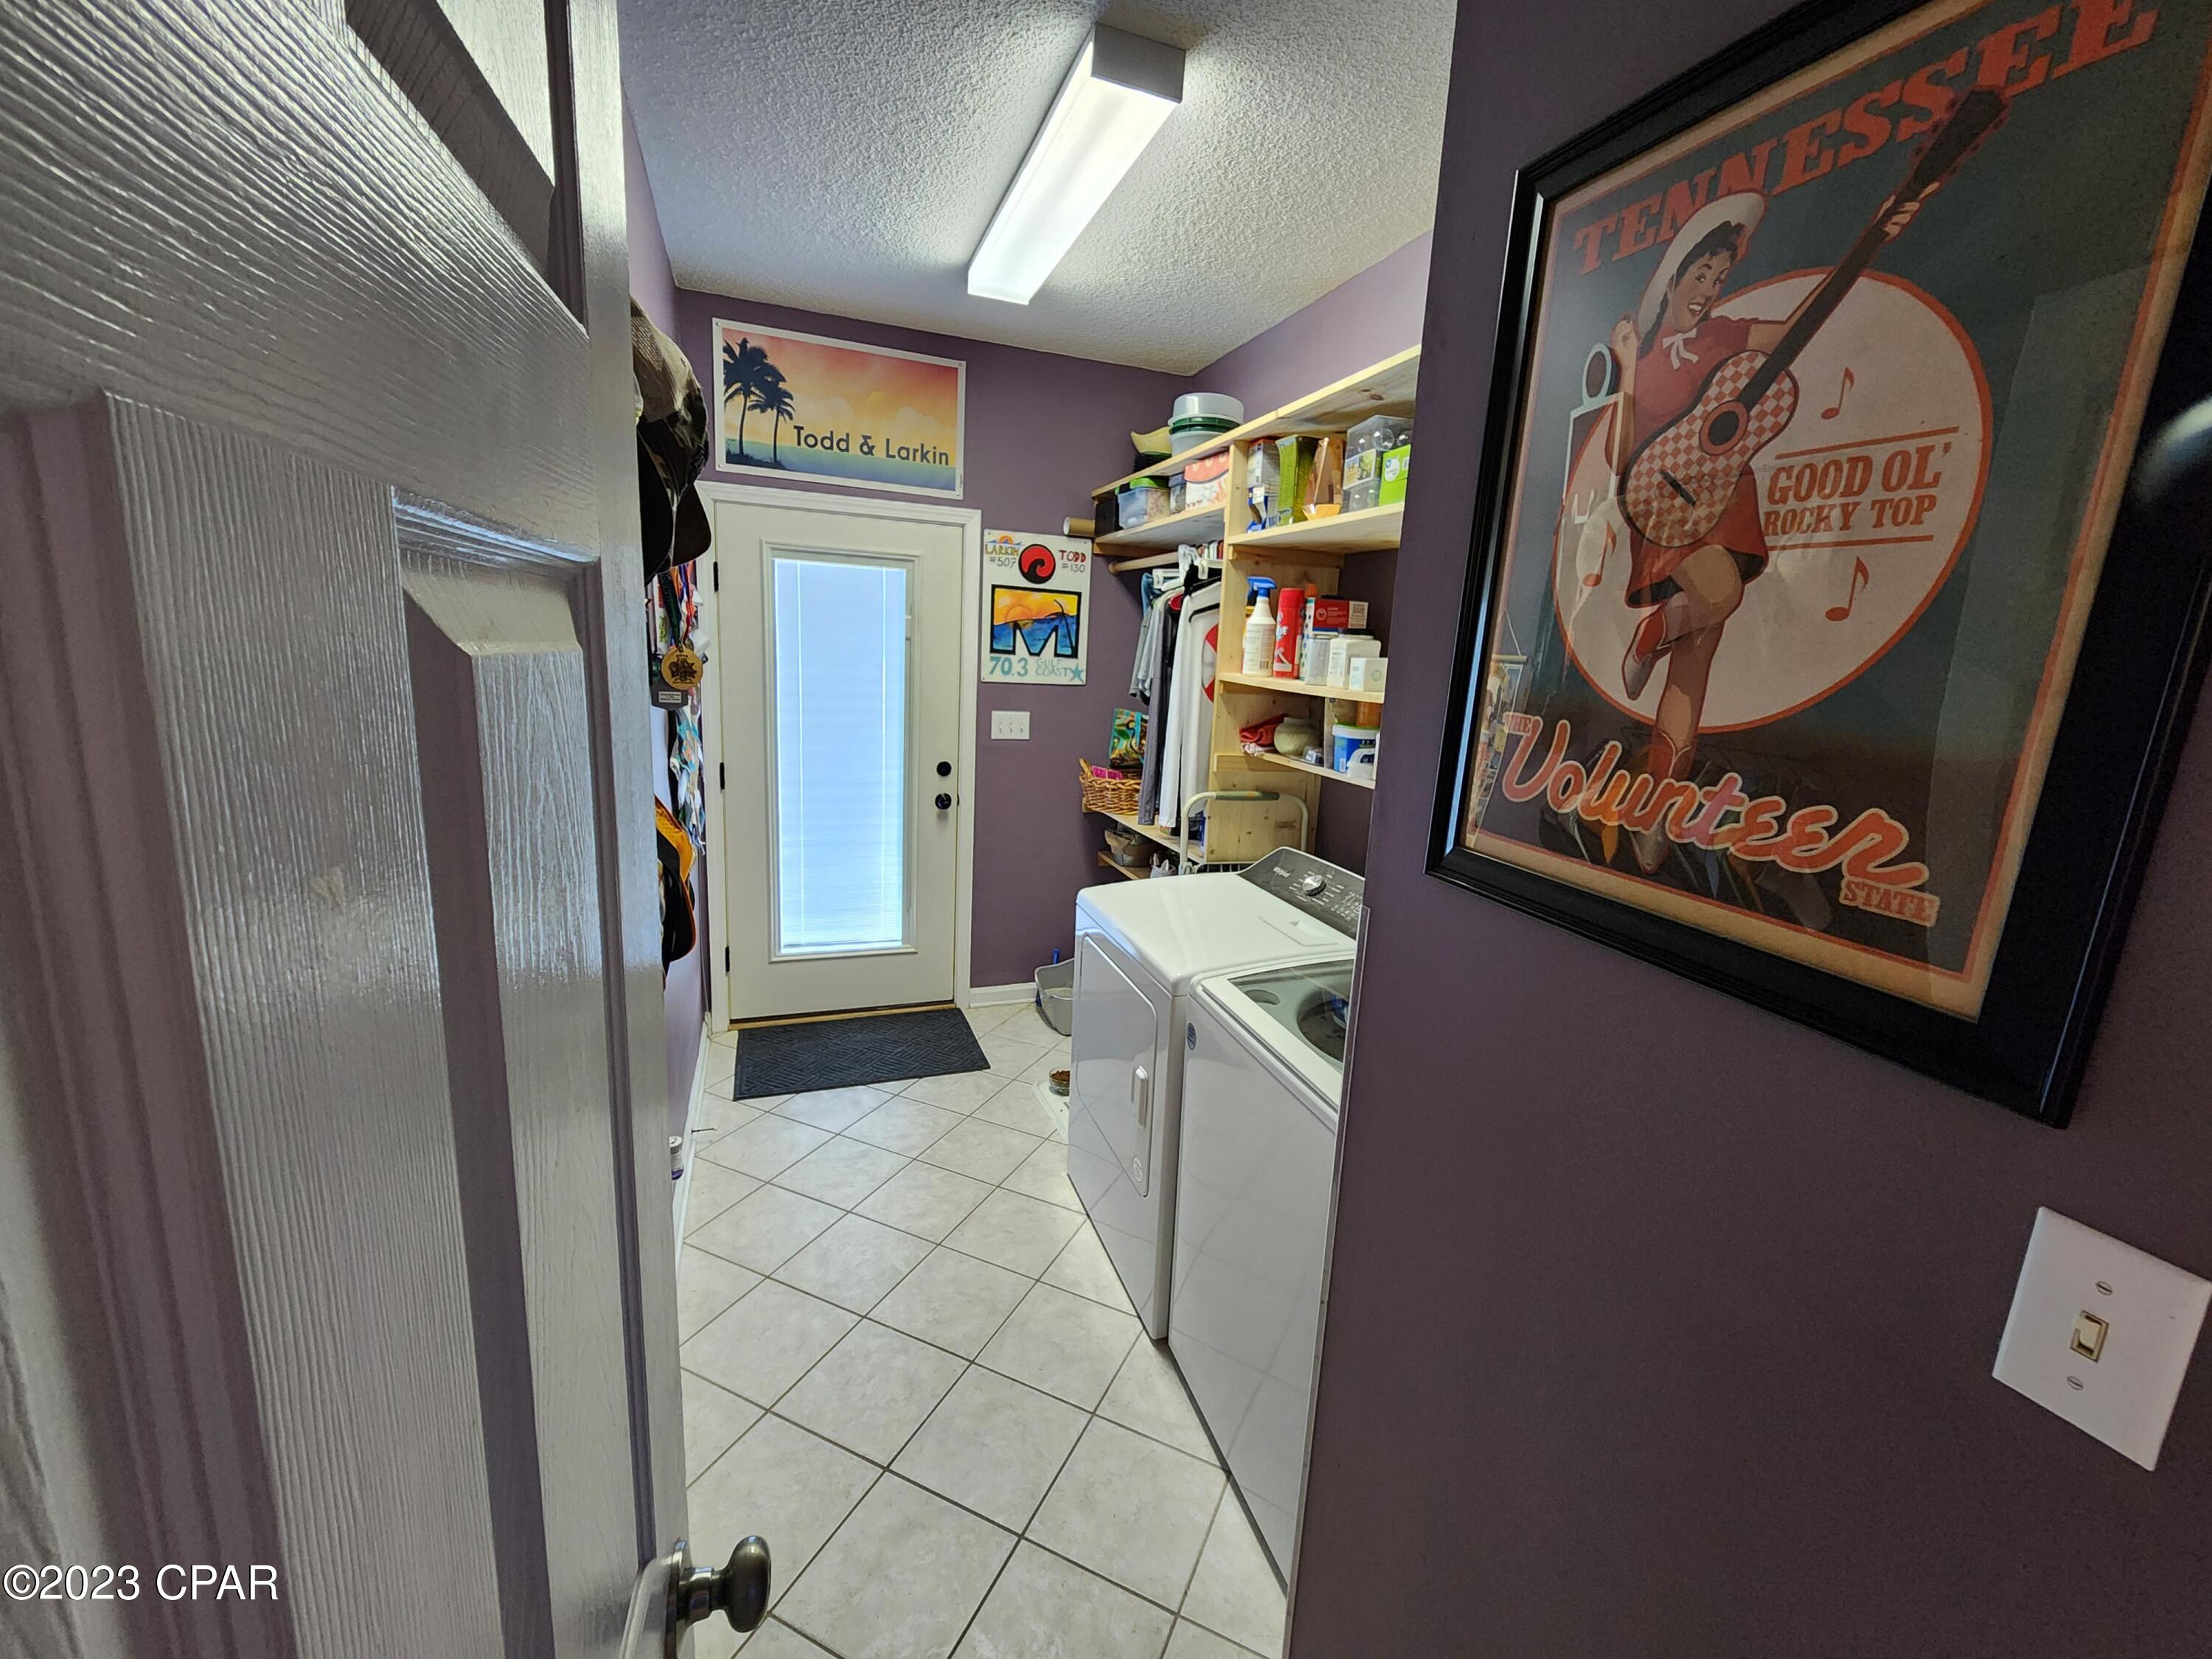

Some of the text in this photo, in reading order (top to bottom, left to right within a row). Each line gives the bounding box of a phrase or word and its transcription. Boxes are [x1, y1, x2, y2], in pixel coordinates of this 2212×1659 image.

[1573, 0, 2159, 276] TENNESSEE
[793, 425, 950, 466] Todd & Larkin
[1767, 442, 1952, 506] GOOD OL'
[1763, 494, 1938, 537] ROCKY TOP
[989, 557, 1017, 569] #507
[1058, 549, 1087, 563] TODD
[989, 655, 1029, 677] 70.3
[1035, 667, 1072, 677] COAST
[1036, 658, 1062, 668] GULF
[1505, 713, 1531, 734] THE
[1843, 881, 1937, 923] STATE
